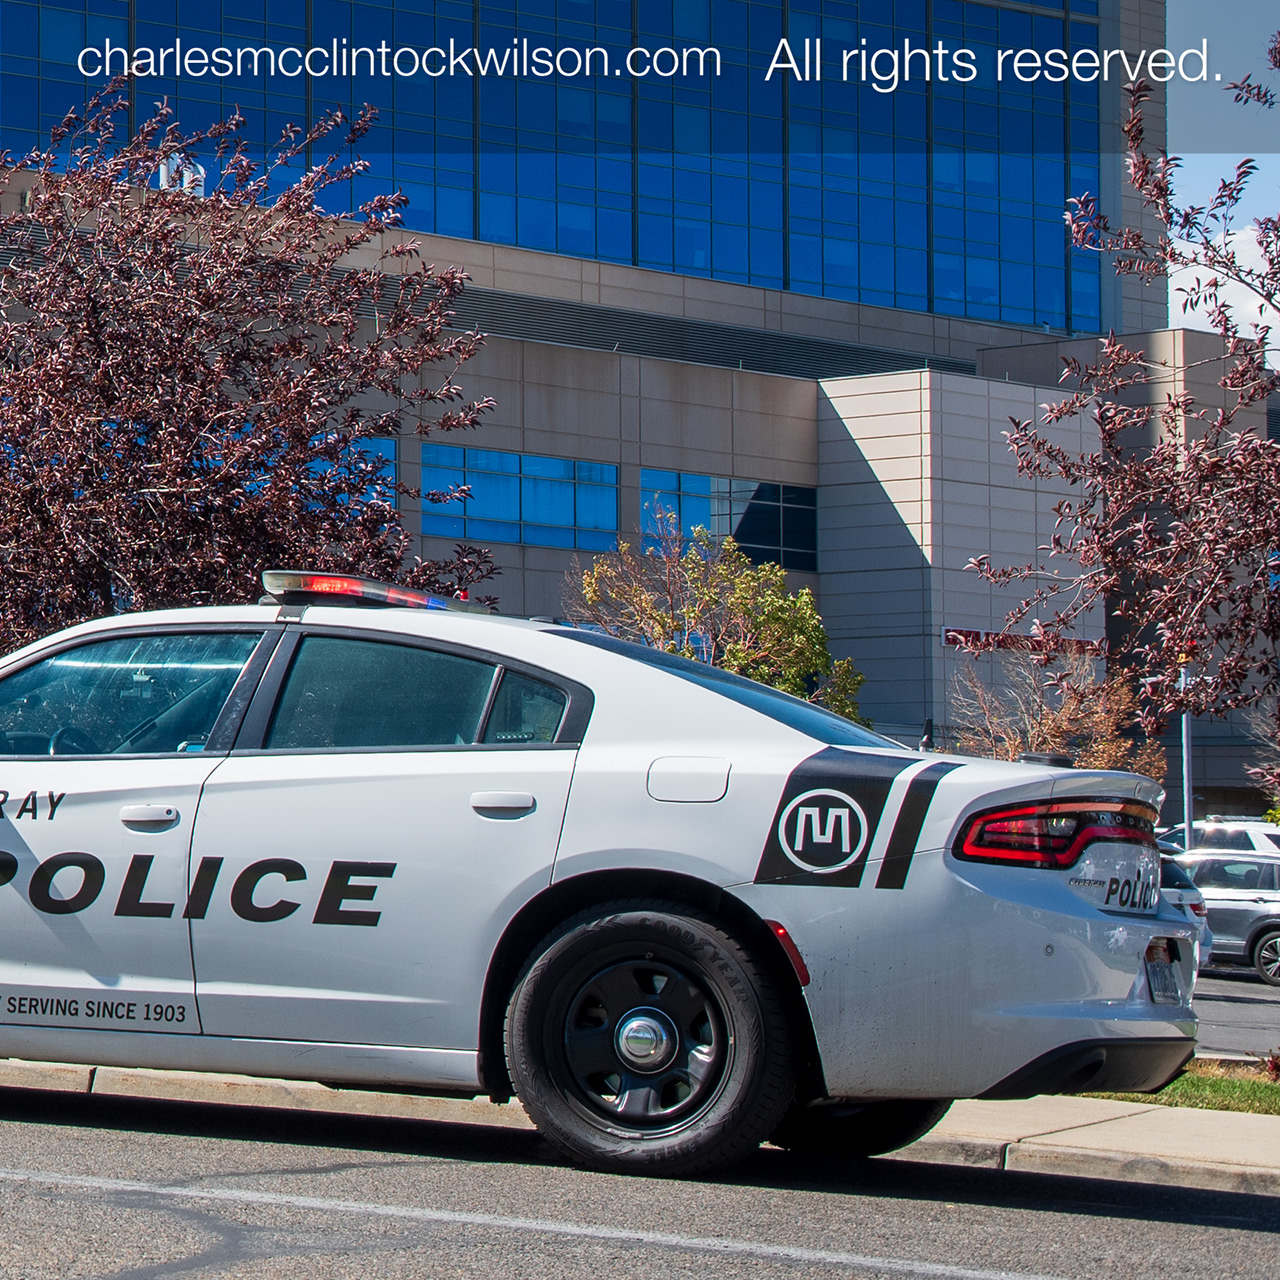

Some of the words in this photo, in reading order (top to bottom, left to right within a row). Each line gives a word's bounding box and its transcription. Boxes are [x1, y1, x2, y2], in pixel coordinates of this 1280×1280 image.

[6, 996, 79, 1017] SERVING
[84, 1000, 137, 1020] SINCE
[143, 1003, 186, 1023] 1903
